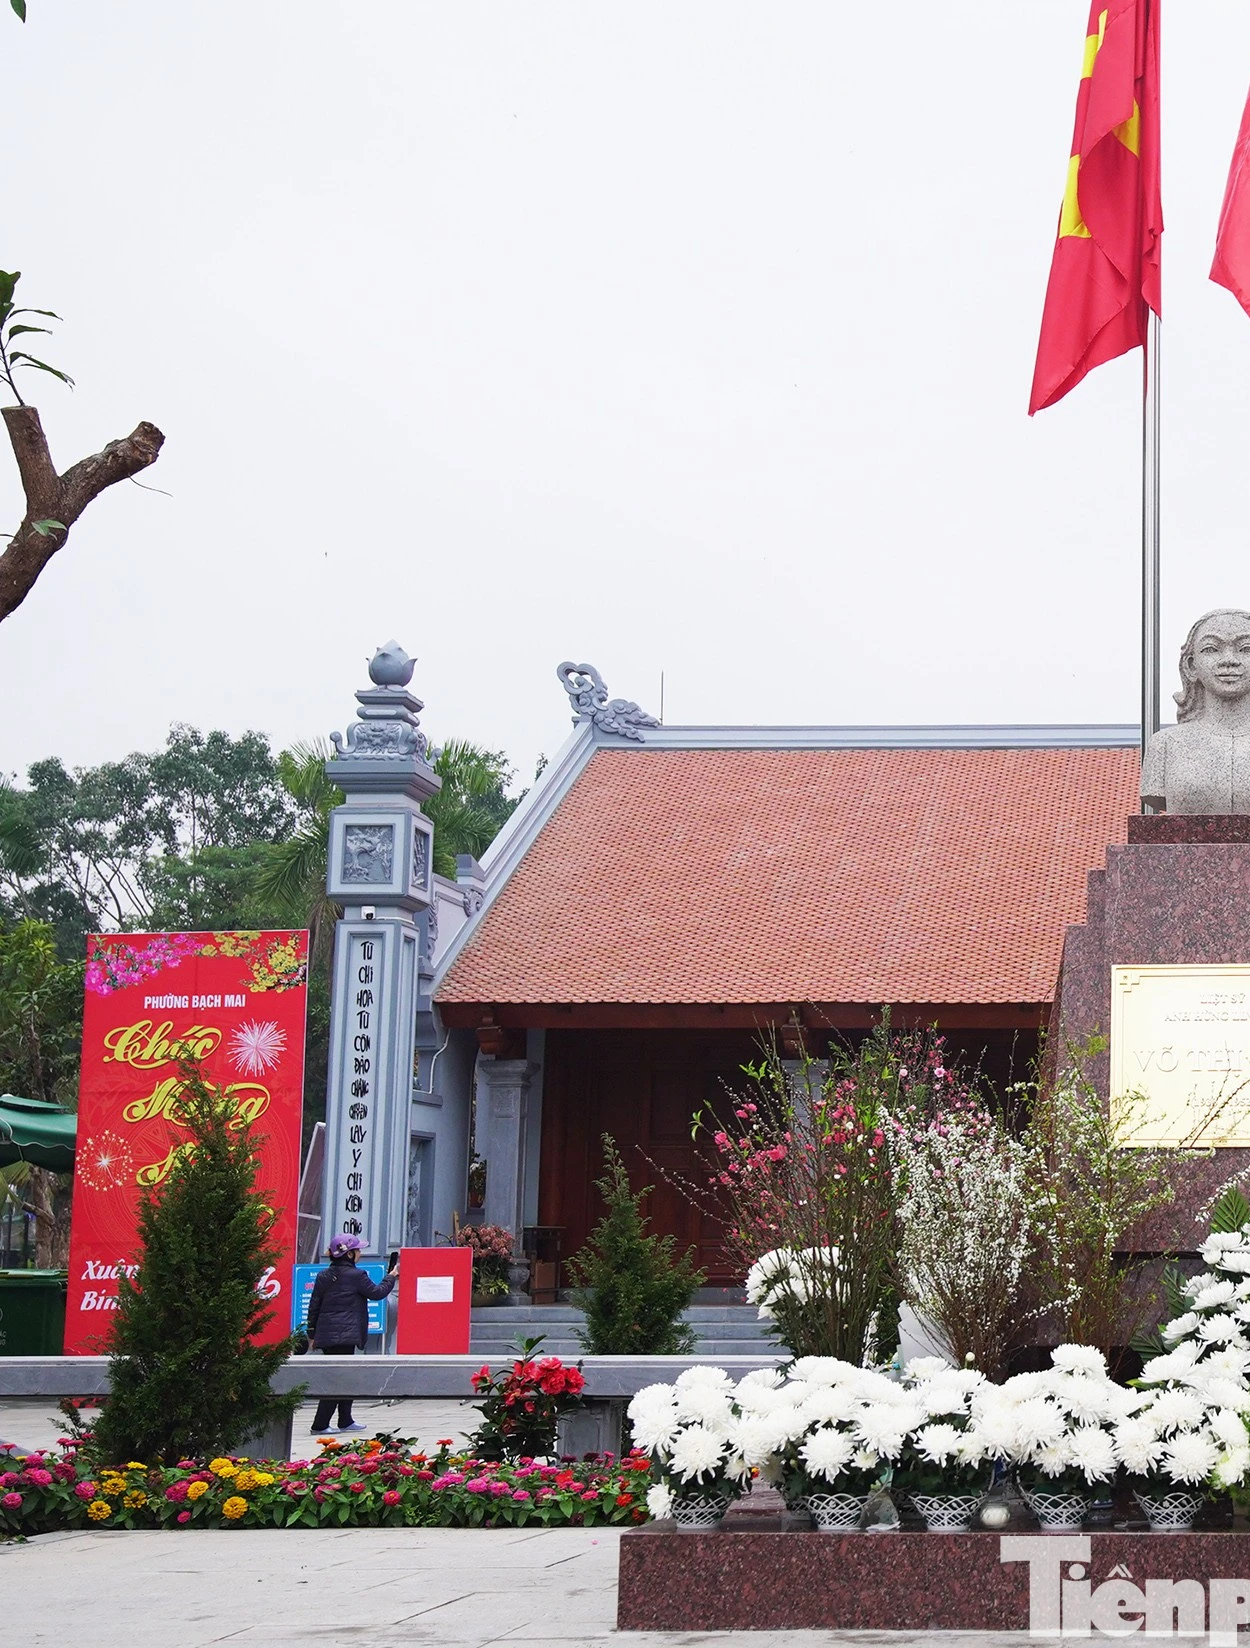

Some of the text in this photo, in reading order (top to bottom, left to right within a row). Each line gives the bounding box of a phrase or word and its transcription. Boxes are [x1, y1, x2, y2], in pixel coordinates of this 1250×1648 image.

[144, 992, 246, 1011] PHƯỜNG BẠCH MAI
[354, 1033, 371, 1053] CÔN
[1133, 1045, 1180, 1073] VÕ
[350, 1125, 367, 1144] LAY
[352, 1148, 362, 1168] Ý
